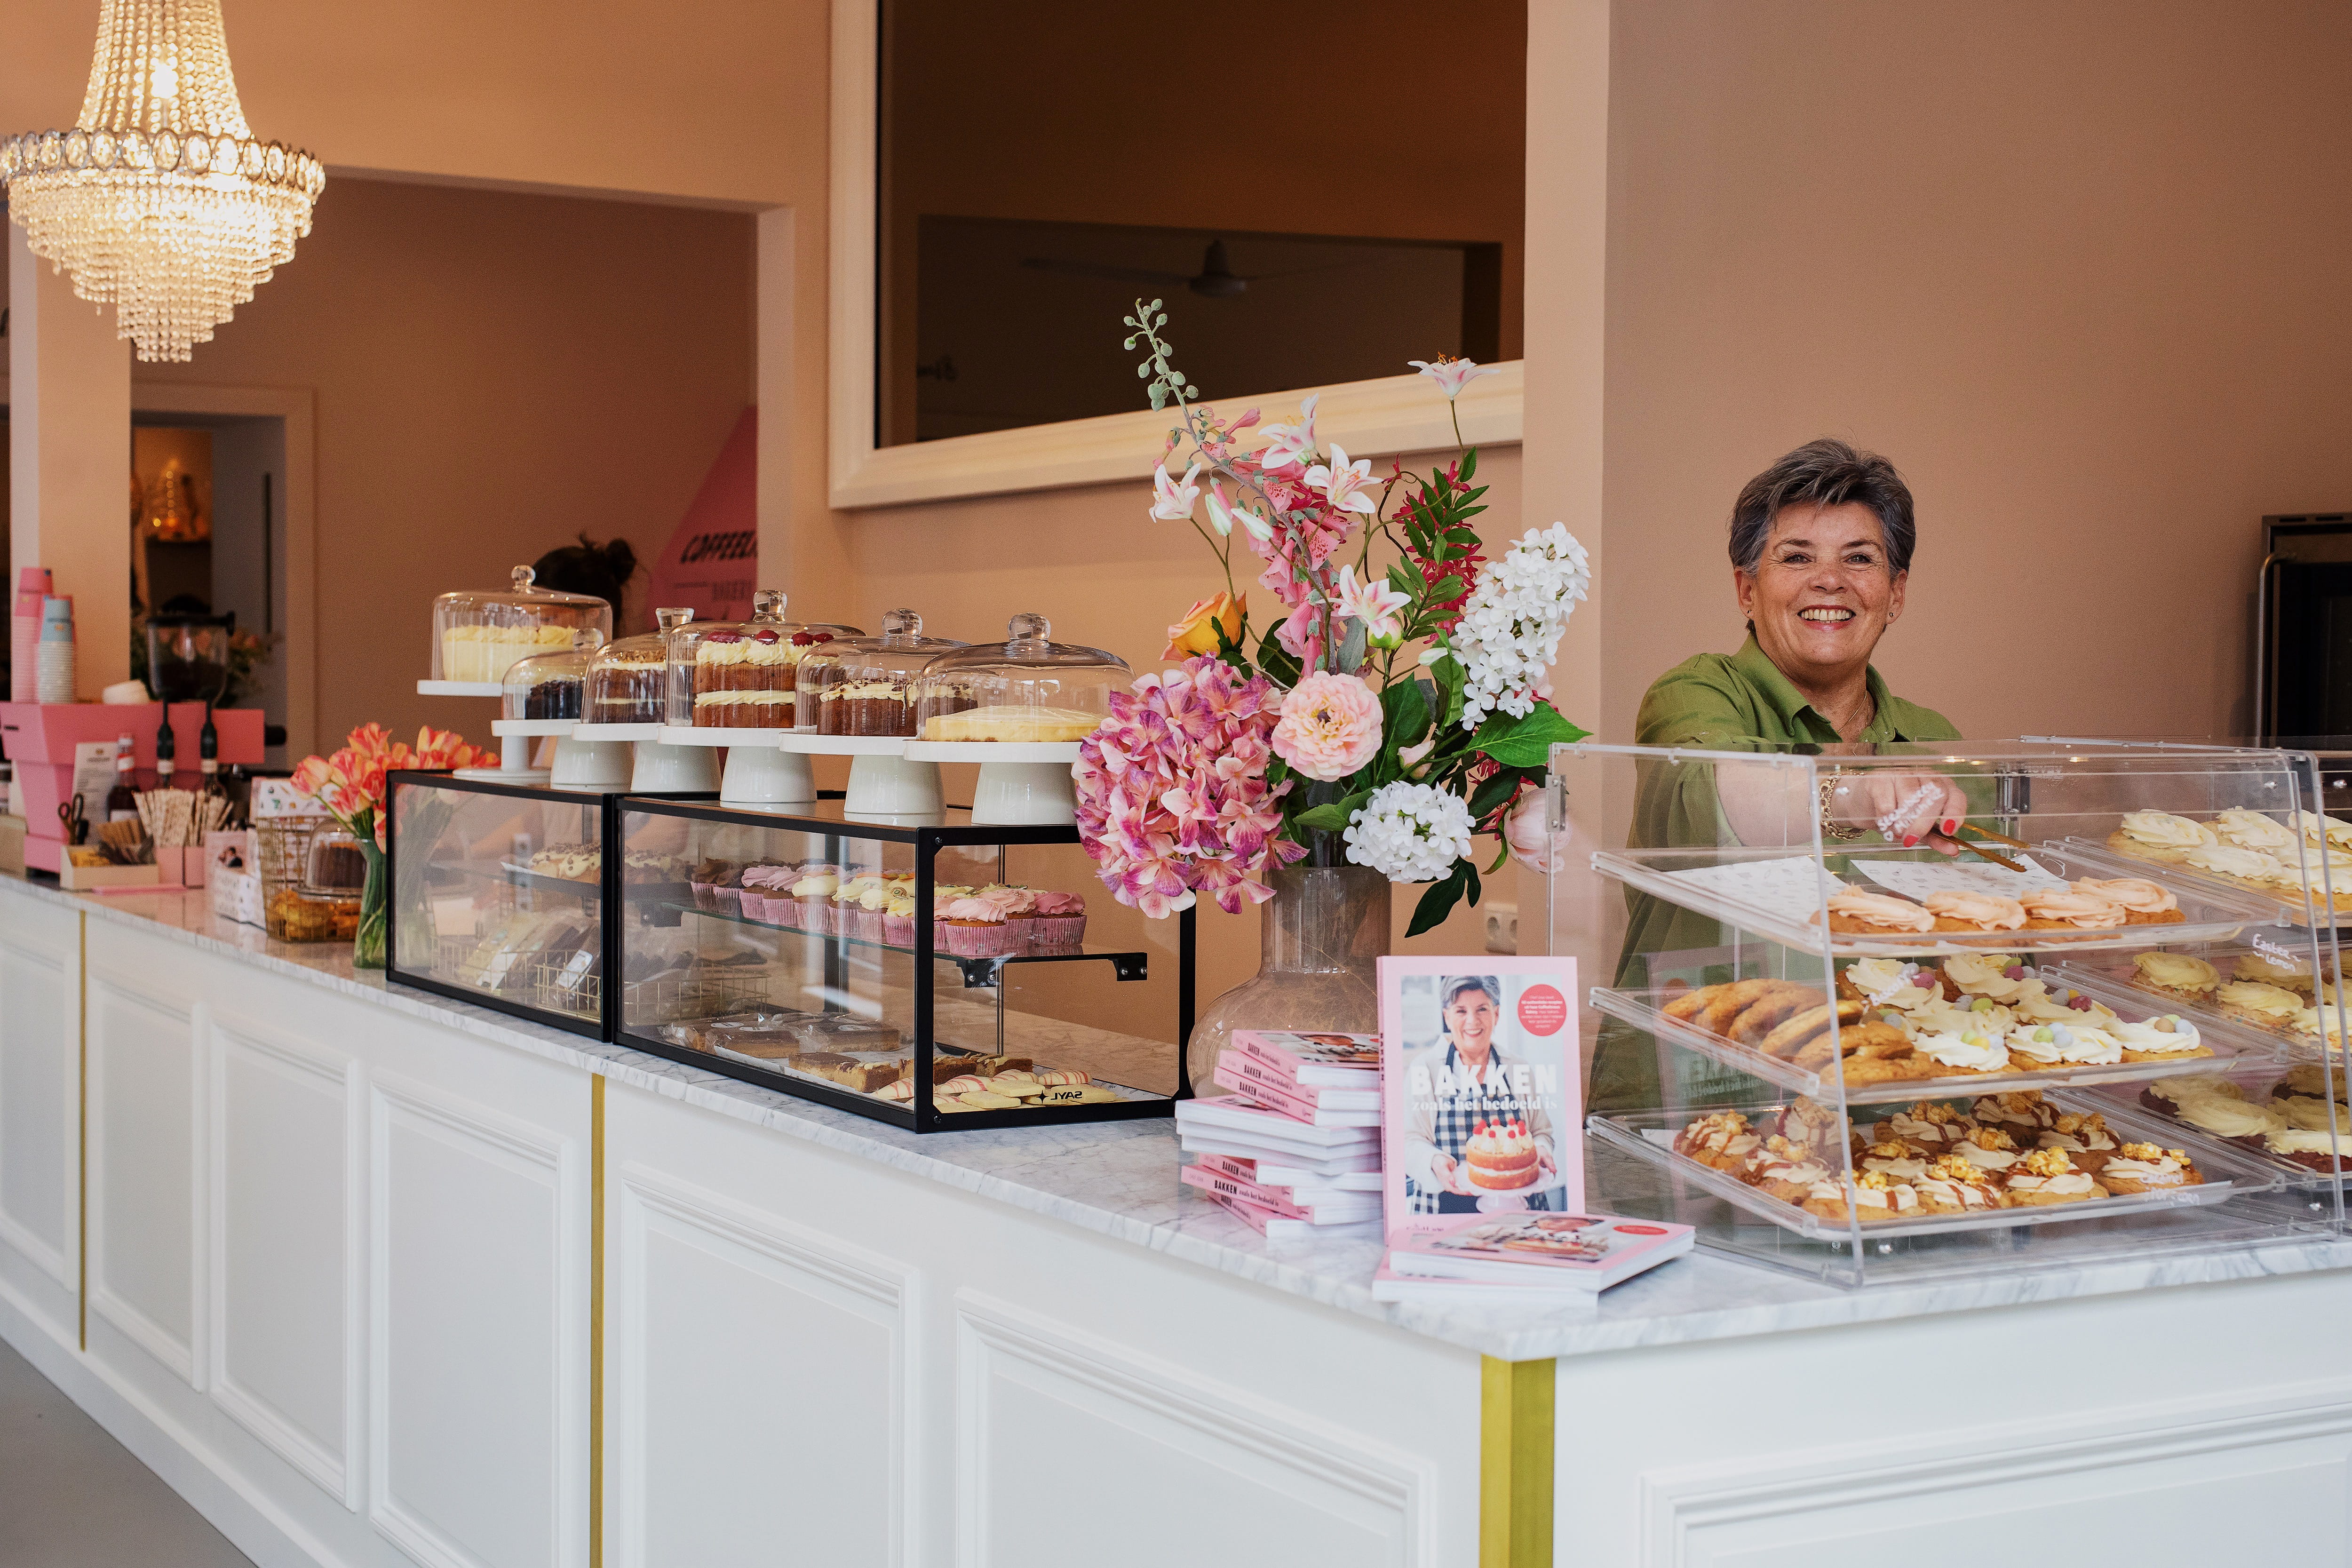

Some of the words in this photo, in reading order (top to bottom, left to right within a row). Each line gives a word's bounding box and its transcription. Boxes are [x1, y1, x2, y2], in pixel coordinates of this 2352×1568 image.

[1244, 1064, 1262, 1079] BAKKEN
[1410, 1064, 1557, 1096] BAKKEN
[1239, 1081, 1257, 1096] BAKKEN
[1412, 1097, 1451, 1111] zoals
[1454, 1096, 1480, 1111] het
[1482, 1095, 1541, 1111] bedoeld
[1545, 1096, 1557, 1109] is
[1222, 1161, 1240, 1176] BAKKEN
[1214, 1179, 1238, 1194] BAKKEN
